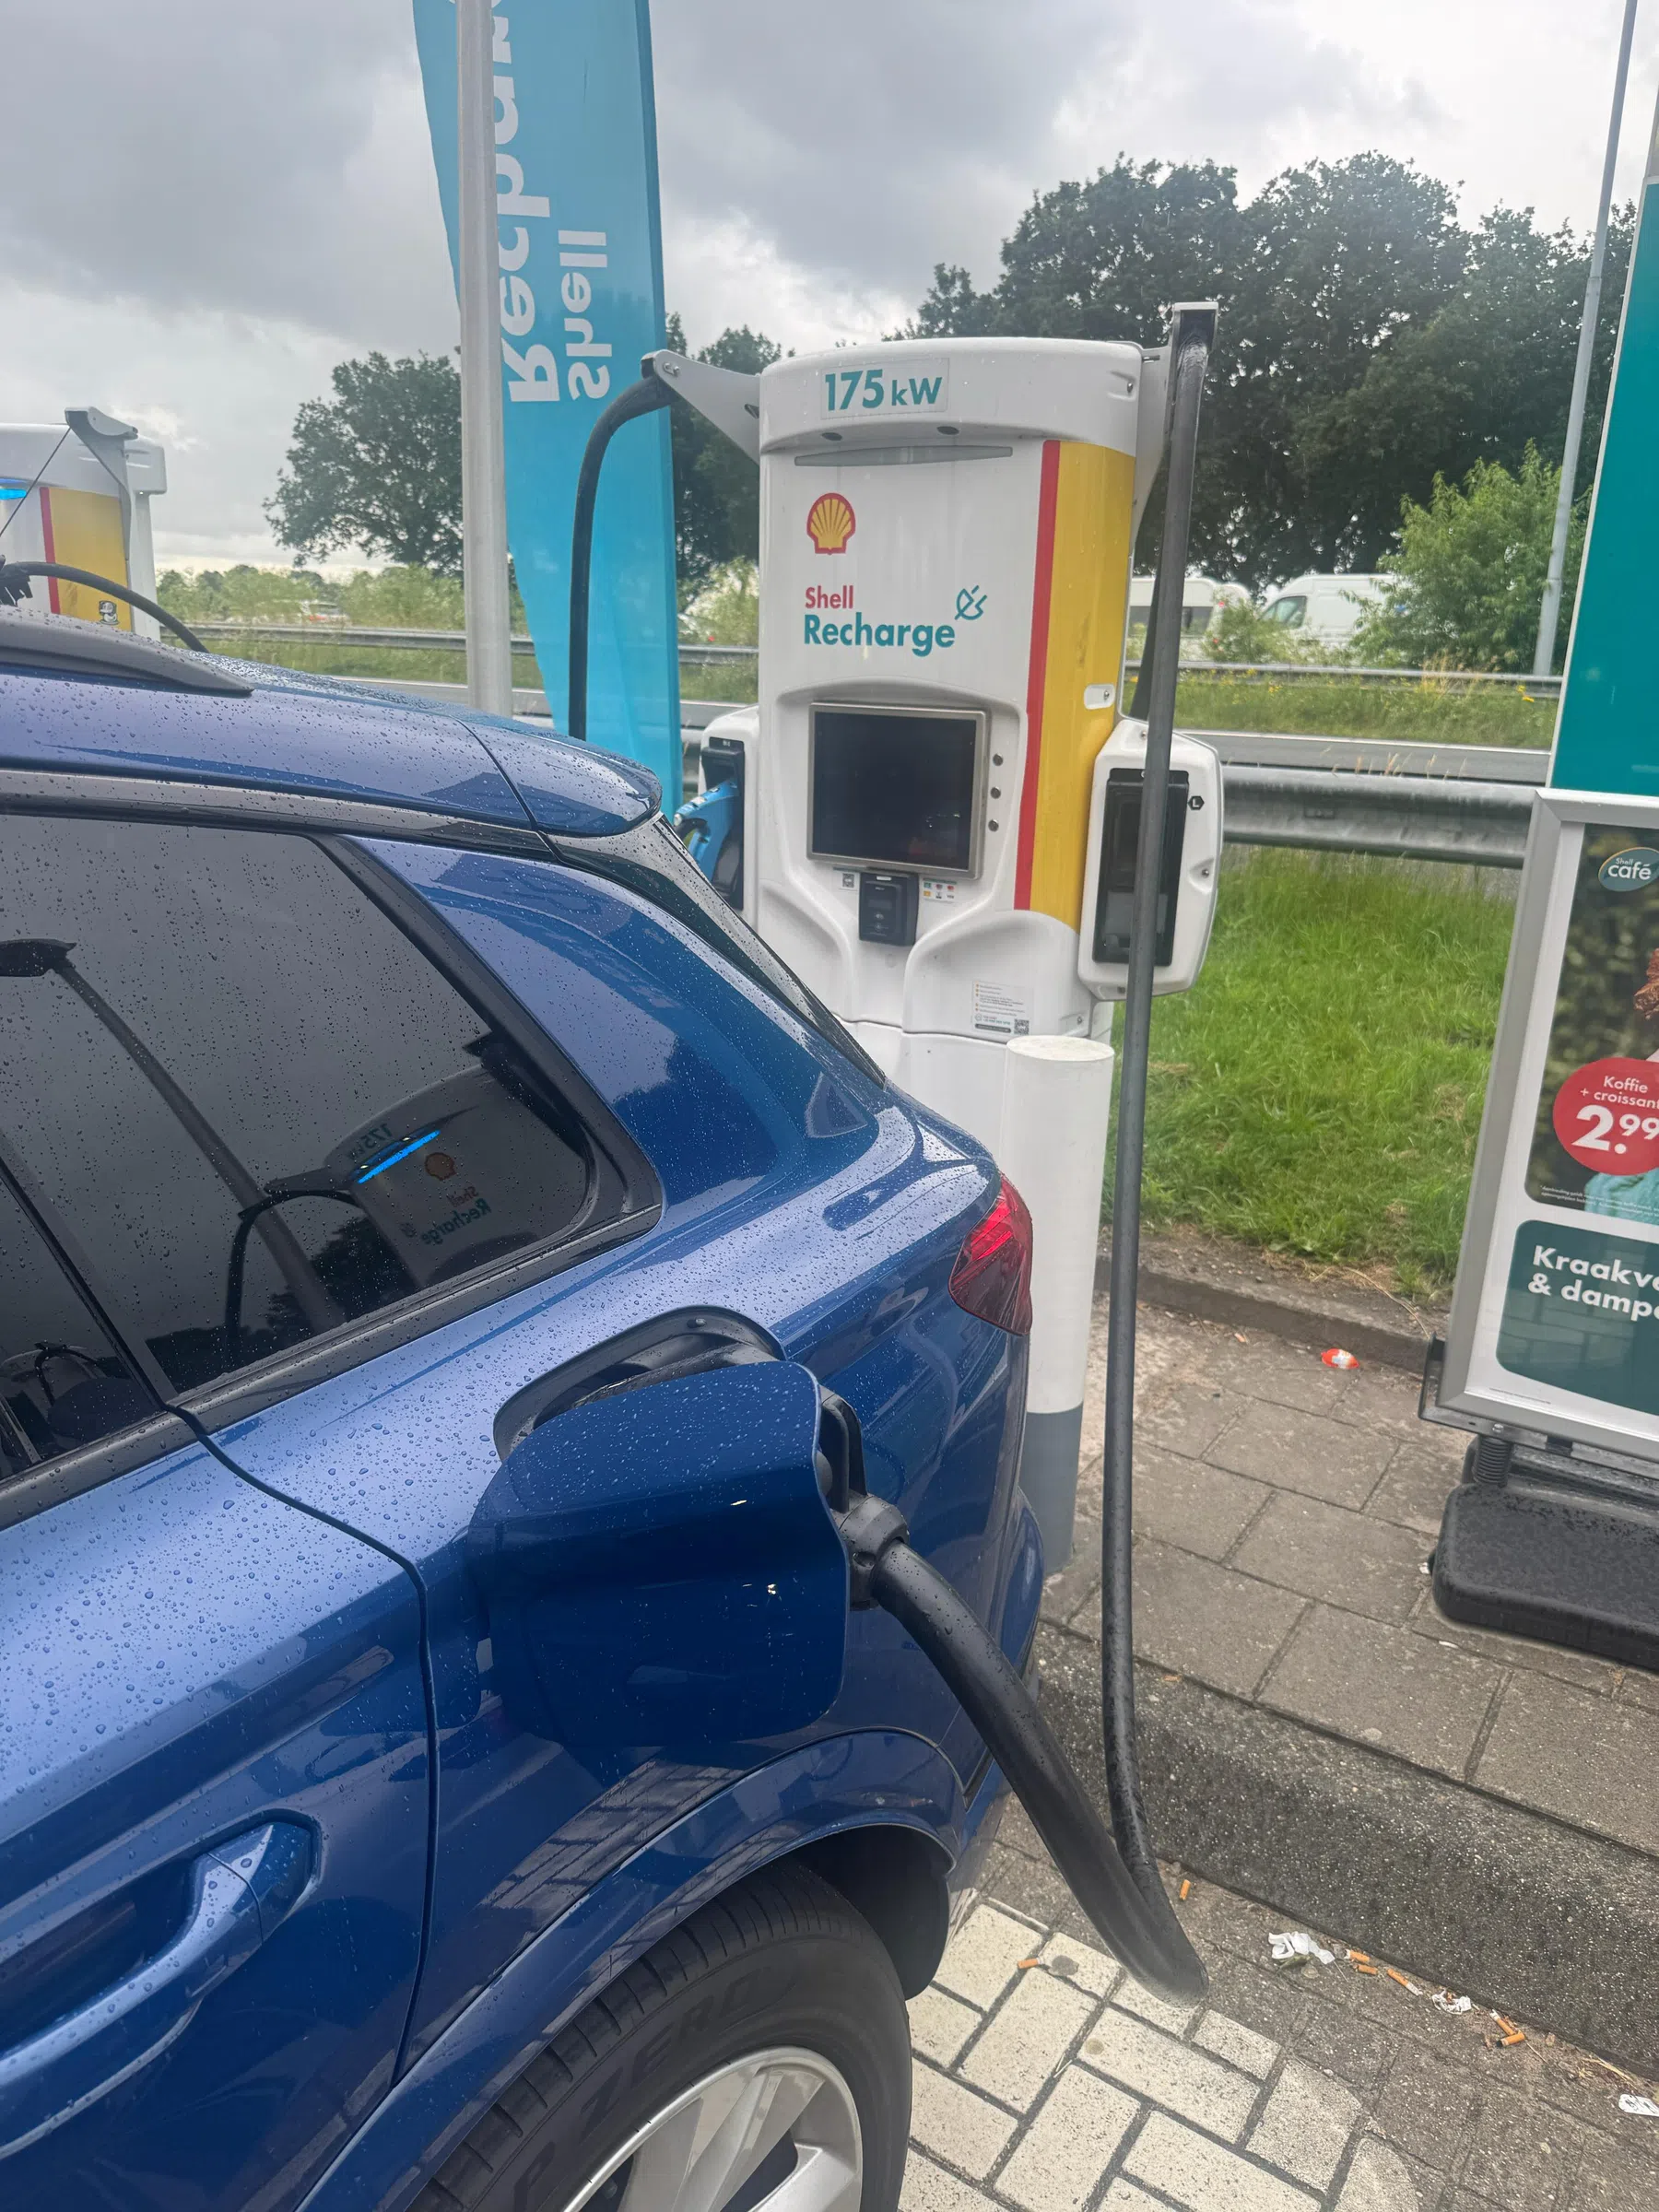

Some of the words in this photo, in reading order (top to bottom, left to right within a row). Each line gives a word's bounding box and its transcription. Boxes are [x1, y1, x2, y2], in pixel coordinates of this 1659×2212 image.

[805, 584, 854, 609] Shell
[804, 611, 956, 657] Recharge
[1607, 861, 1652, 880] café
[1615, 857, 1634, 865] Shell
[1603, 1075, 1649, 1094] Koffie
[1527, 1272, 1551, 1296] &
